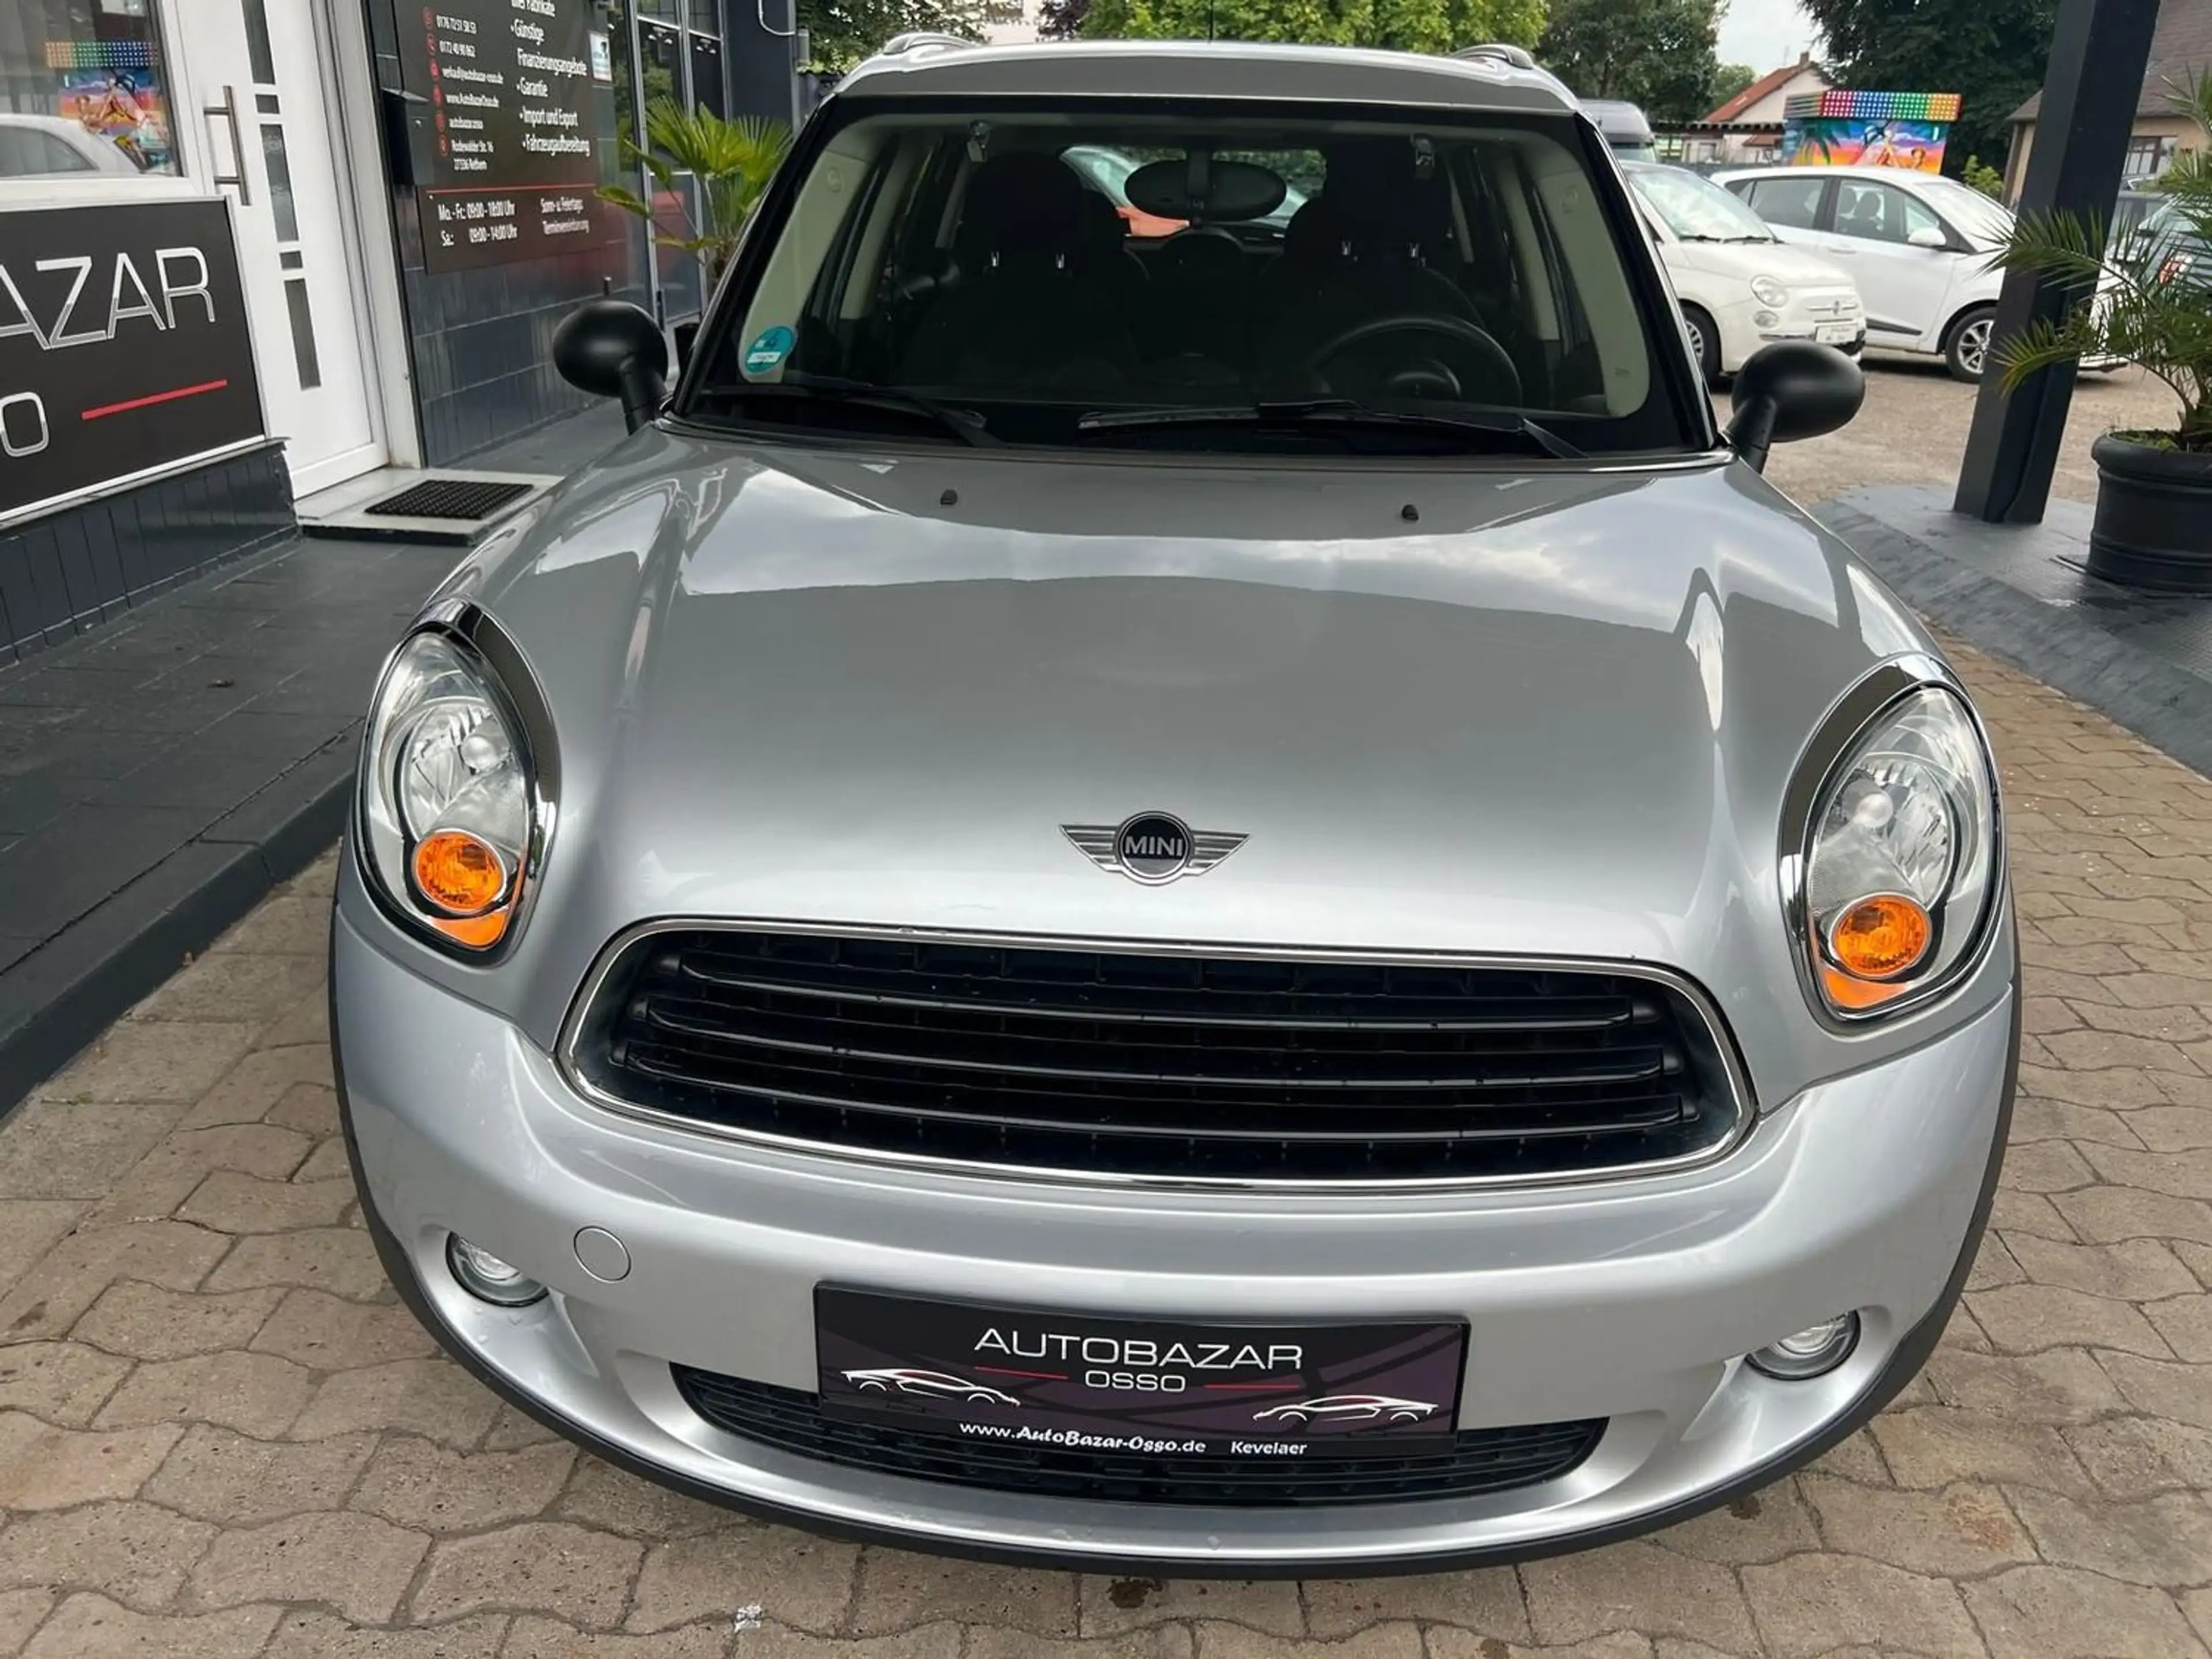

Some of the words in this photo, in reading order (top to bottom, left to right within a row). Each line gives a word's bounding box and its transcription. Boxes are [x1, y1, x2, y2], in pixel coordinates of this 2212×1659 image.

[1125, 835, 1183, 857] MINI
[974, 1328, 1303, 1370] AUTOBAZAR
[1085, 1370, 1187, 1393] OSSO
[960, 1420, 1206, 1456] www.AutoBazar-Osso.de
[1230, 1441, 1308, 1456] Kevelaer
